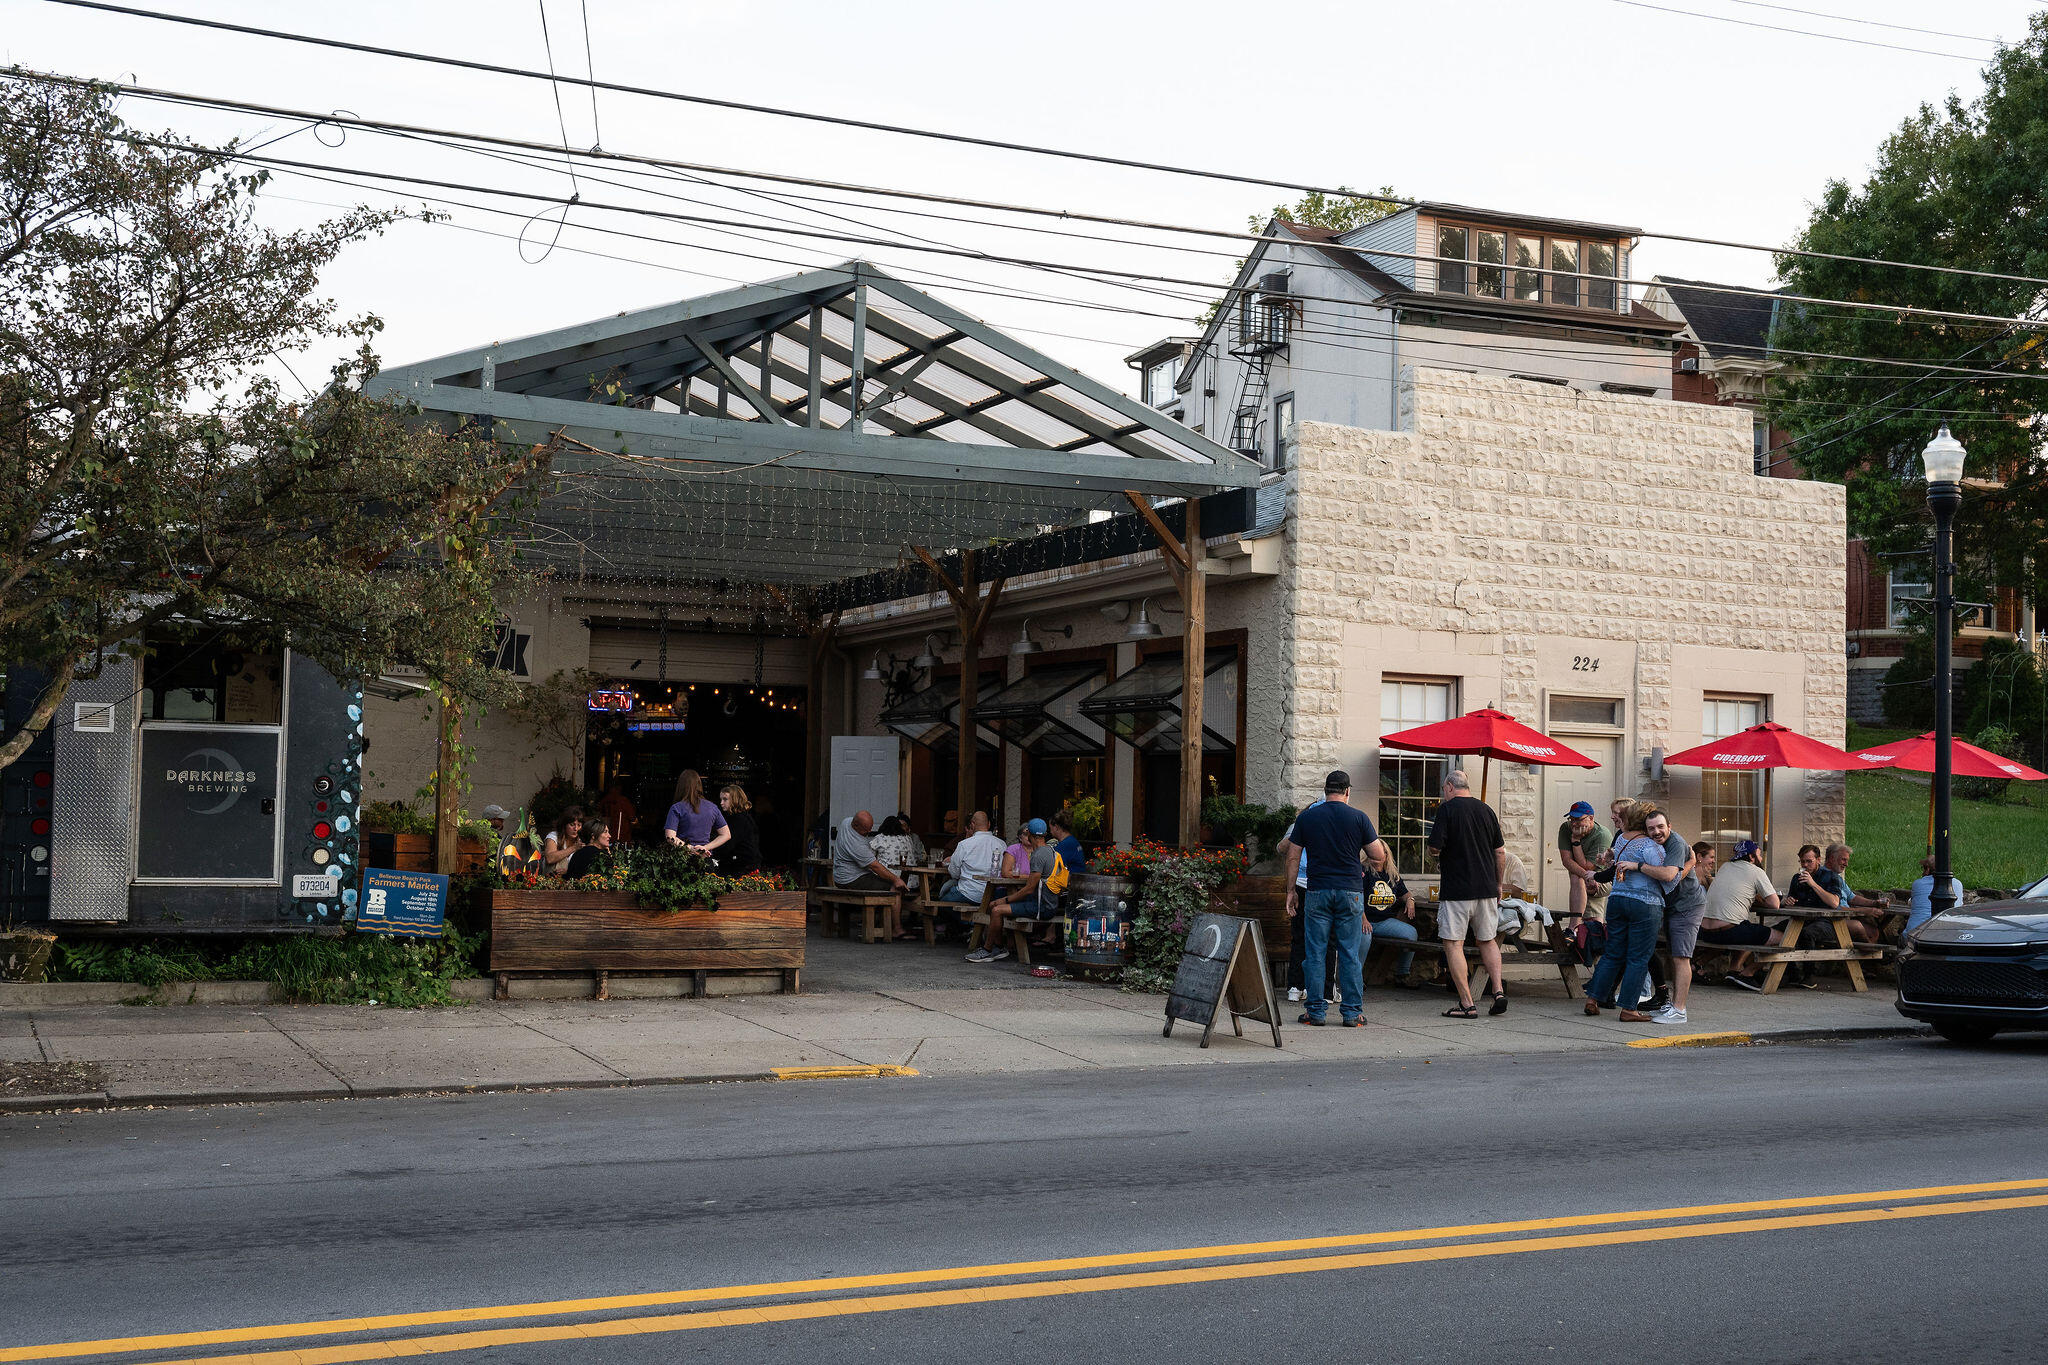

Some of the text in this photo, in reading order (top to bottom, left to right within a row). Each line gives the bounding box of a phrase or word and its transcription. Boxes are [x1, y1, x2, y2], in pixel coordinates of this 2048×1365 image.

[1571, 656, 1600, 672] 224
[1713, 753, 1767, 762] CIDERBOYS
[166, 769, 257, 784] DARKNESS
[188, 784, 248, 792] BREWING
[300, 880, 330, 891] 873204
[369, 877, 440, 891] Farmers Market
